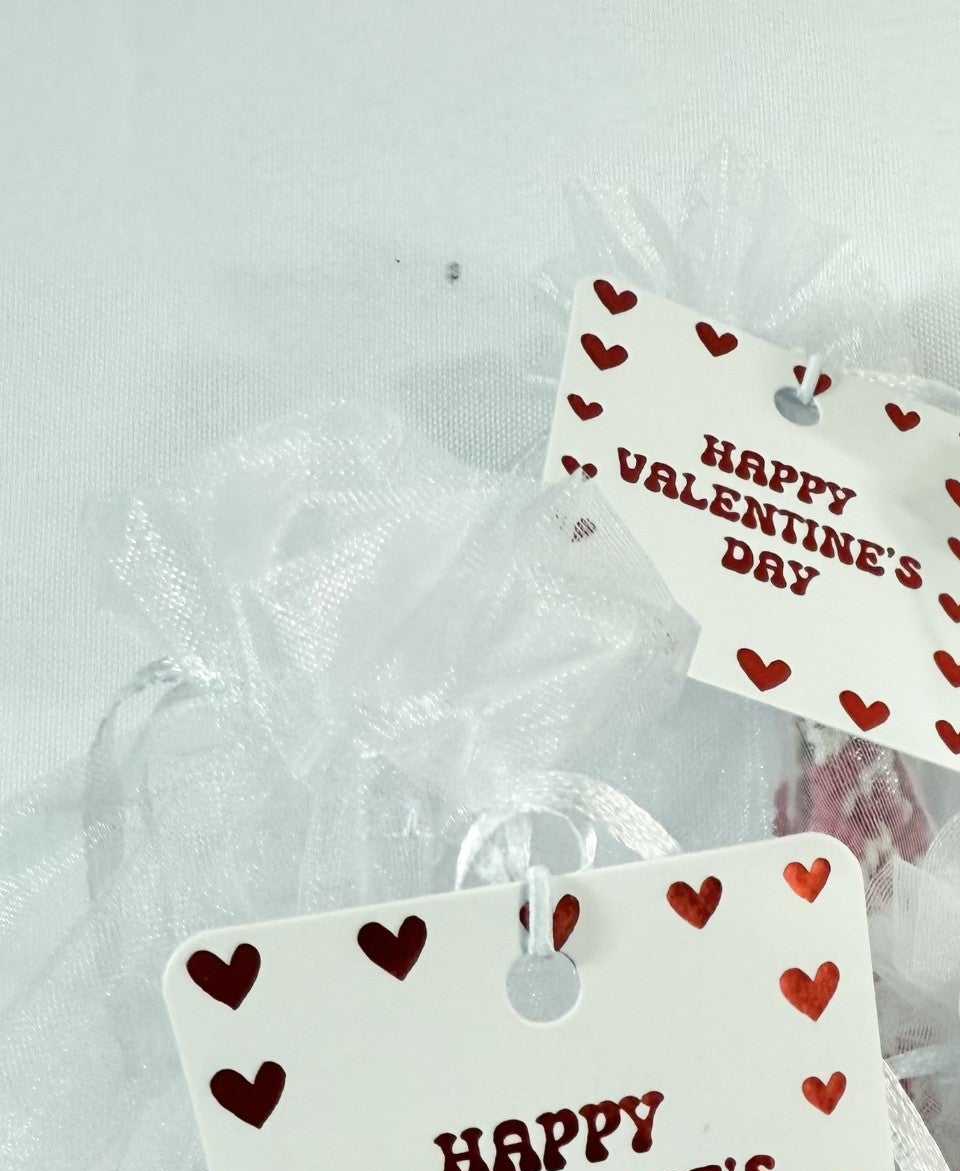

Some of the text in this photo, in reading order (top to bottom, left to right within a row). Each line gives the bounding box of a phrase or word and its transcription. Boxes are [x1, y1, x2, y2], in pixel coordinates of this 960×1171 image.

[701, 434, 857, 515] HAPPY
[618, 447, 922, 589] VALENTINE'S
[721, 536, 820, 596] DAY
